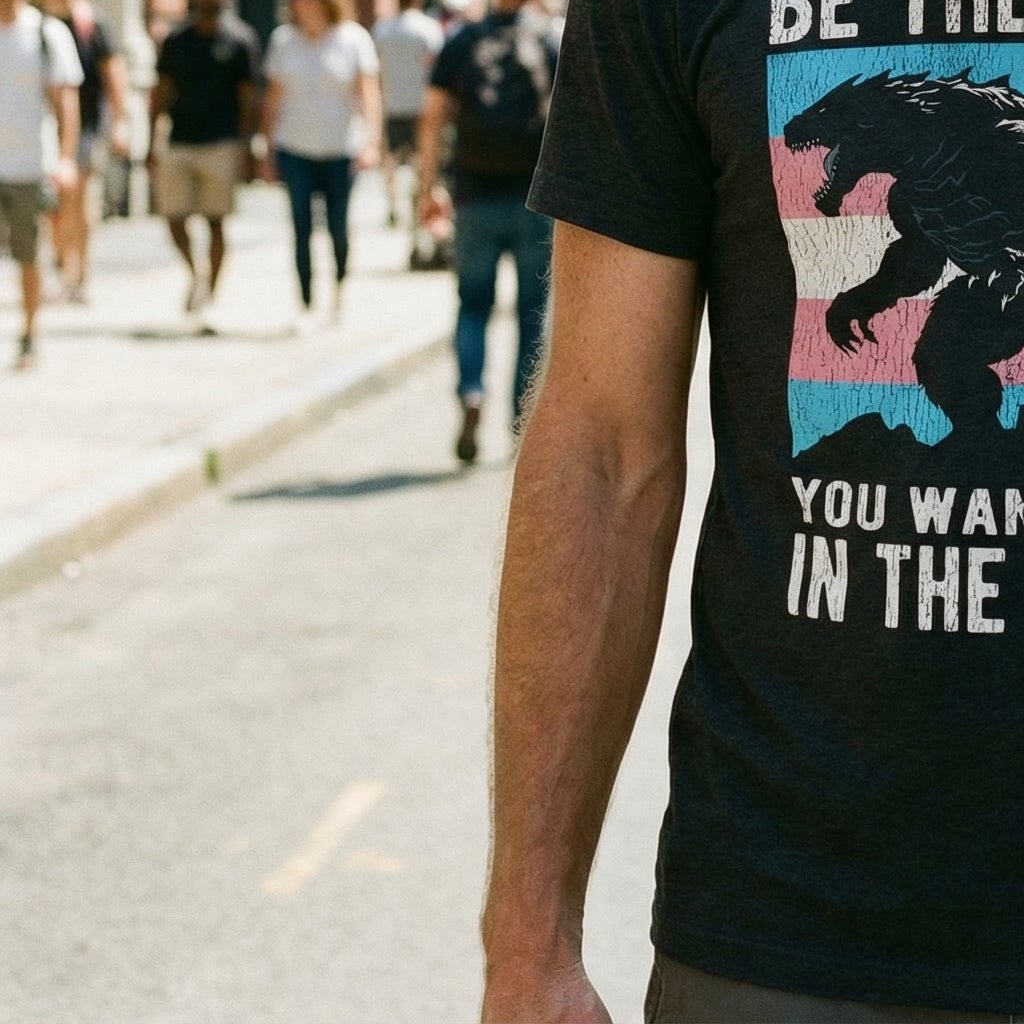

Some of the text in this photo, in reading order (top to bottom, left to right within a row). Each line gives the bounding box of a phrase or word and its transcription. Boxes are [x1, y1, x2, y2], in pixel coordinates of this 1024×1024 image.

[792, 477, 886, 530] YOU
[788, 533, 847, 622] IN
[876, 543, 1005, 633] THE
